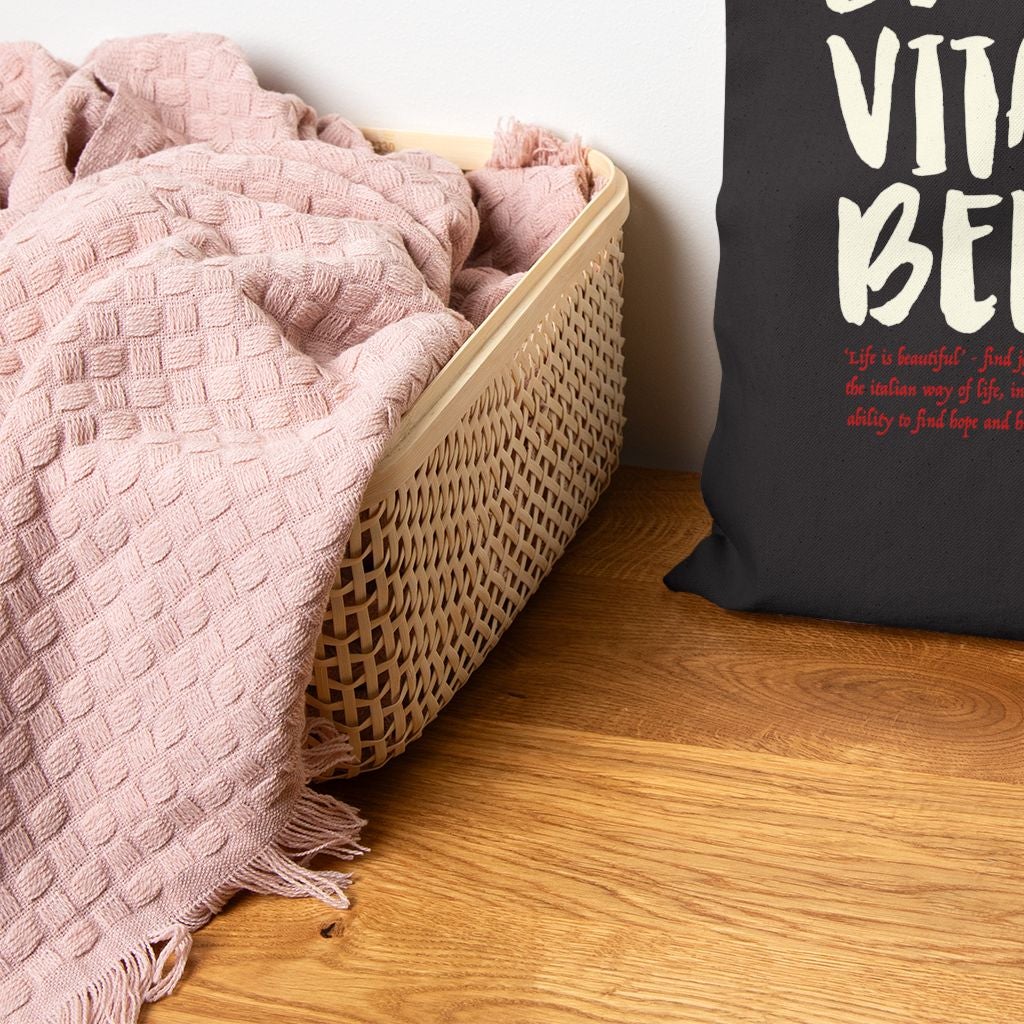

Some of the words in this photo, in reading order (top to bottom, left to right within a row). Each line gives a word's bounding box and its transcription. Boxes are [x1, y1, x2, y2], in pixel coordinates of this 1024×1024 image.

[881, 349, 893, 366] is
[978, 345, 1014, 374] find
[845, 374, 865, 397] the
[870, 375, 917, 398] italian
[922, 384, 954, 408] way
[958, 376, 974, 406] of
[976, 376, 1004, 406] life,
[1010, 382, 1024, 399] in
[847, 405, 895, 438] ability
[898, 413, 911, 429] to
[910, 406, 947, 436] find
[949, 408, 979, 440] hope
[983, 409, 1010, 432] and
